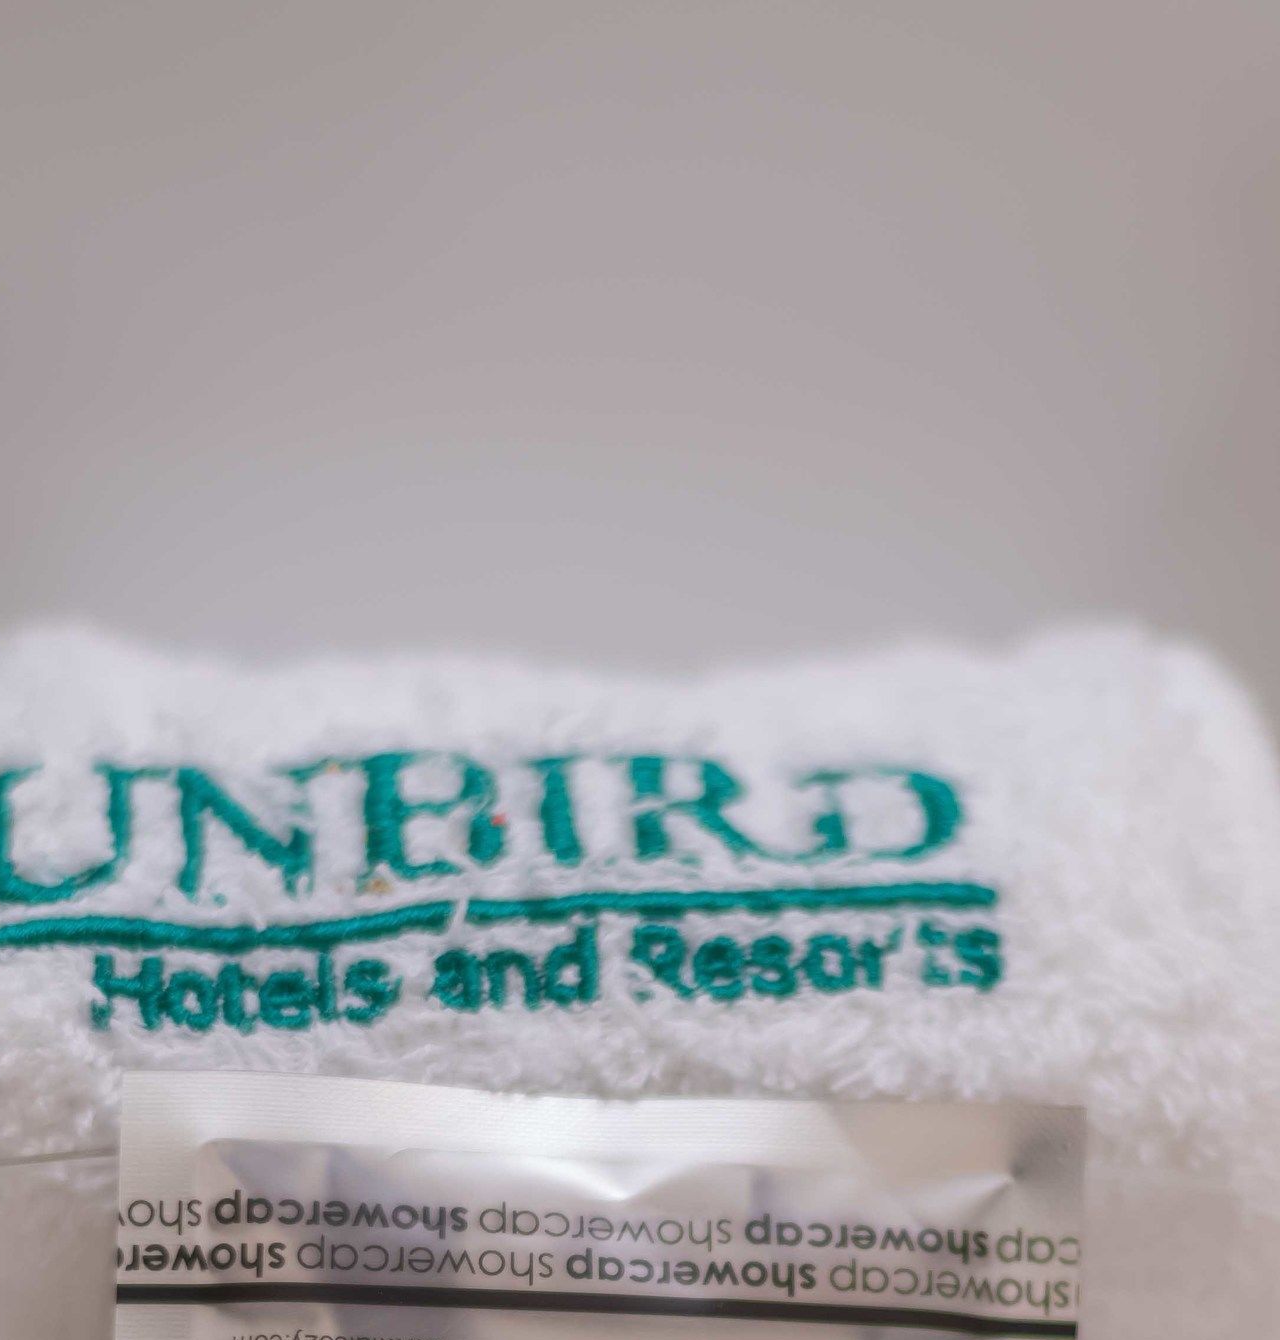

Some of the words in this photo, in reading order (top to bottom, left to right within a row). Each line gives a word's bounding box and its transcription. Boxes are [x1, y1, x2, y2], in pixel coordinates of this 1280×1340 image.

[92, 945, 402, 1034] Hotels
[430, 926, 601, 1013] and
[630, 920, 1004, 1002] Resorts
[117, 1198, 202, 1236] sho
[214, 1188, 469, 1239] showercap
[479, 1200, 733, 1252] showercap
[744, 1213, 988, 1264] showercap
[297, 1234, 554, 1286] showercap
[566, 1246, 818, 1297] showercap
[829, 1258, 1069, 1317] showercap
